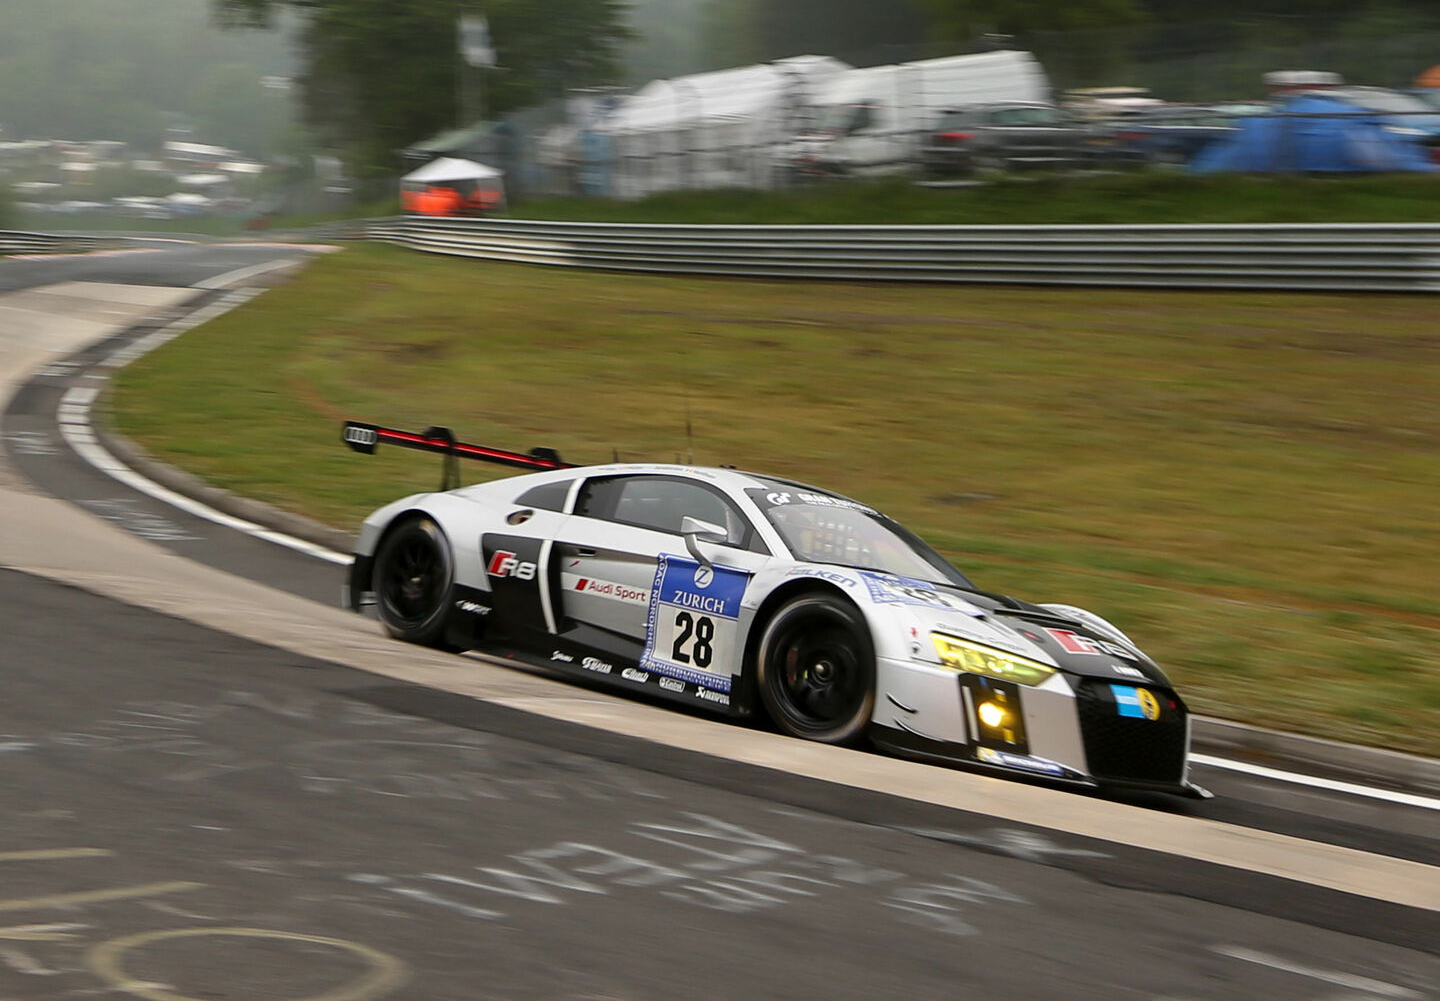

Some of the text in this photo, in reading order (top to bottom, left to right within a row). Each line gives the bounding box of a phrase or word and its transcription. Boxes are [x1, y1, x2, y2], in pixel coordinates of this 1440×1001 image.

[487, 549, 537, 581] R8
[588, 581, 647, 602] Audi Sport
[673, 590, 725, 614] ZURICH
[672, 610, 715, 669] 28
